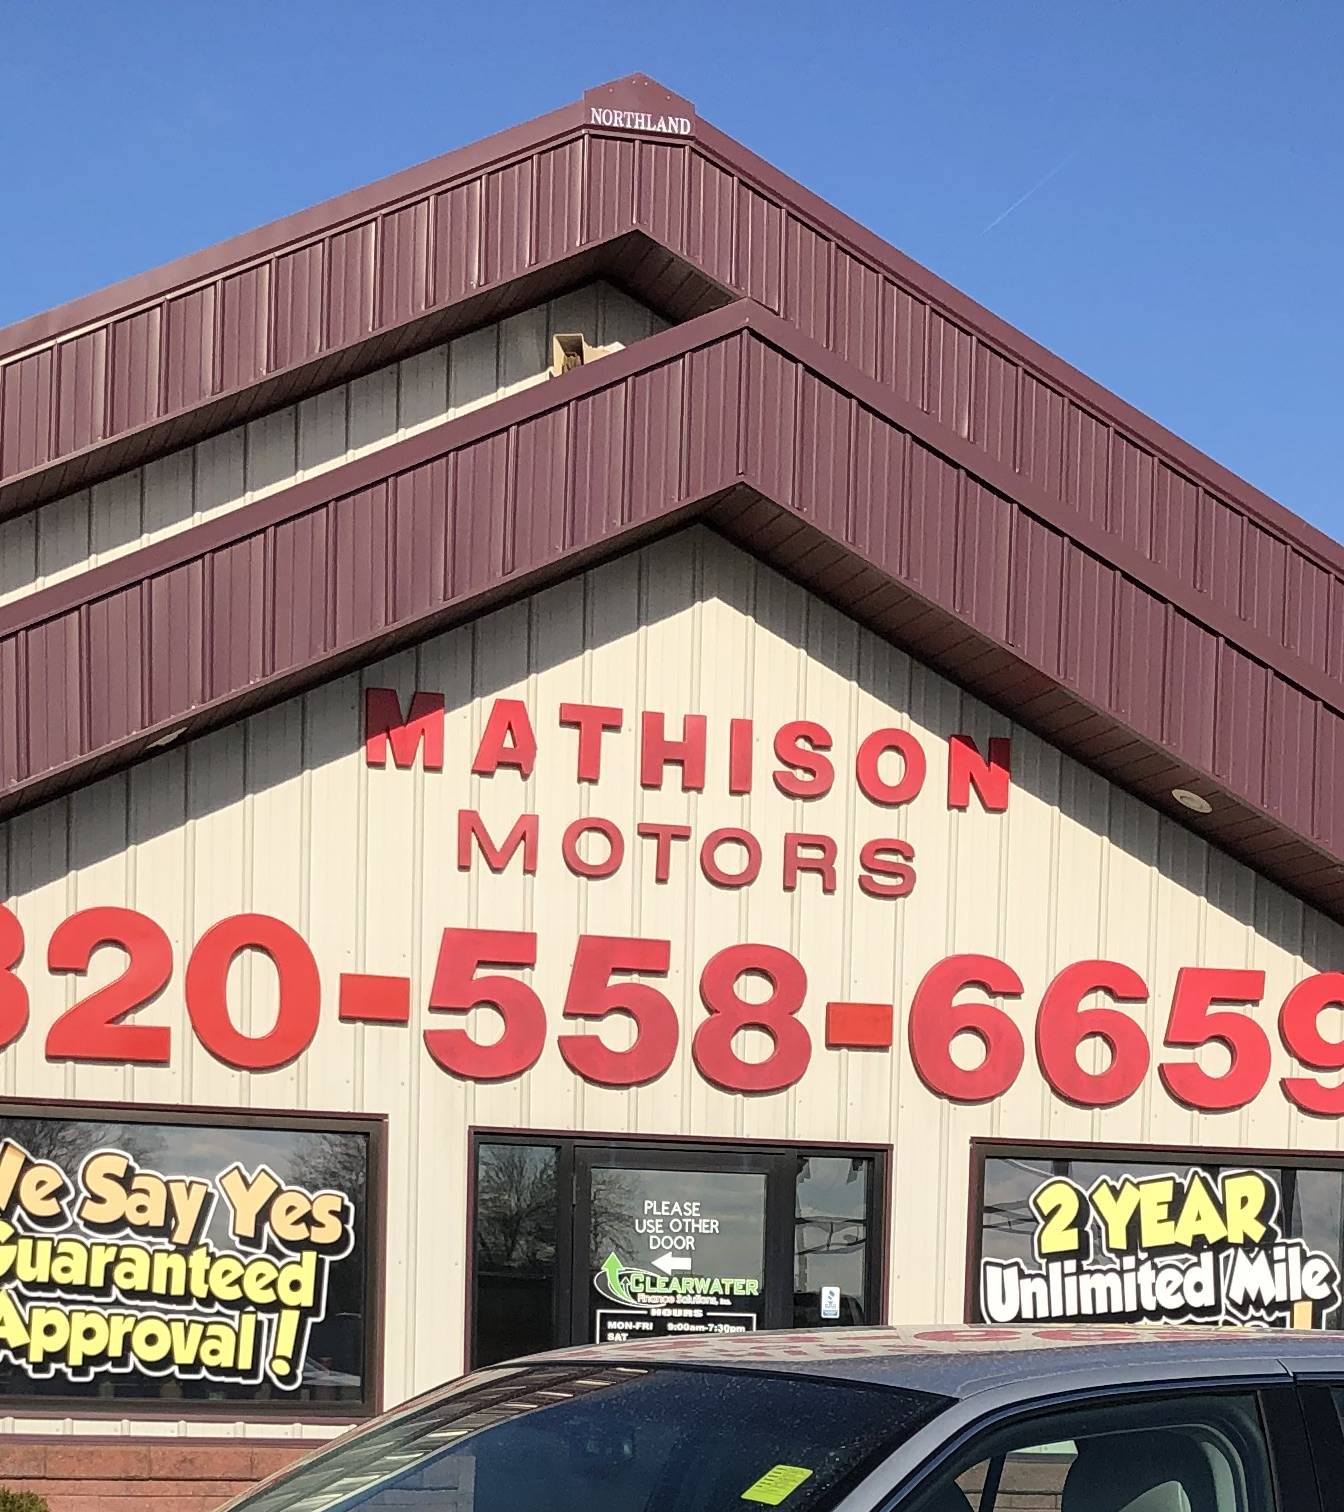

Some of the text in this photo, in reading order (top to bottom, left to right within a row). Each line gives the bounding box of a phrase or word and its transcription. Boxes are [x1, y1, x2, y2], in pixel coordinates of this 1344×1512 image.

[590, 107, 691, 135] NORTHLAND
[364, 687, 1011, 812] MATHISON
[457, 808, 916, 899] MOTORS
[78, 1152, 209, 1245] Say
[218, 1165, 344, 1244] Yes
[643, 1199, 701, 1217] PLEASE
[1032, 1169, 1268, 1255] 2 YEAR
[634, 1217, 720, 1235] USE OTHER
[648, 1235, 696, 1251] DOOR
[629, 1273, 760, 1296] CLEARWATER
[984, 1250, 1216, 1323] Unlimited
[1226, 1244, 1334, 1308] Mile
[649, 1308, 704, 1318] HOURS
[606, 1321, 654, 1331] MON-FRI
[606, 1332, 630, 1342] SAT
